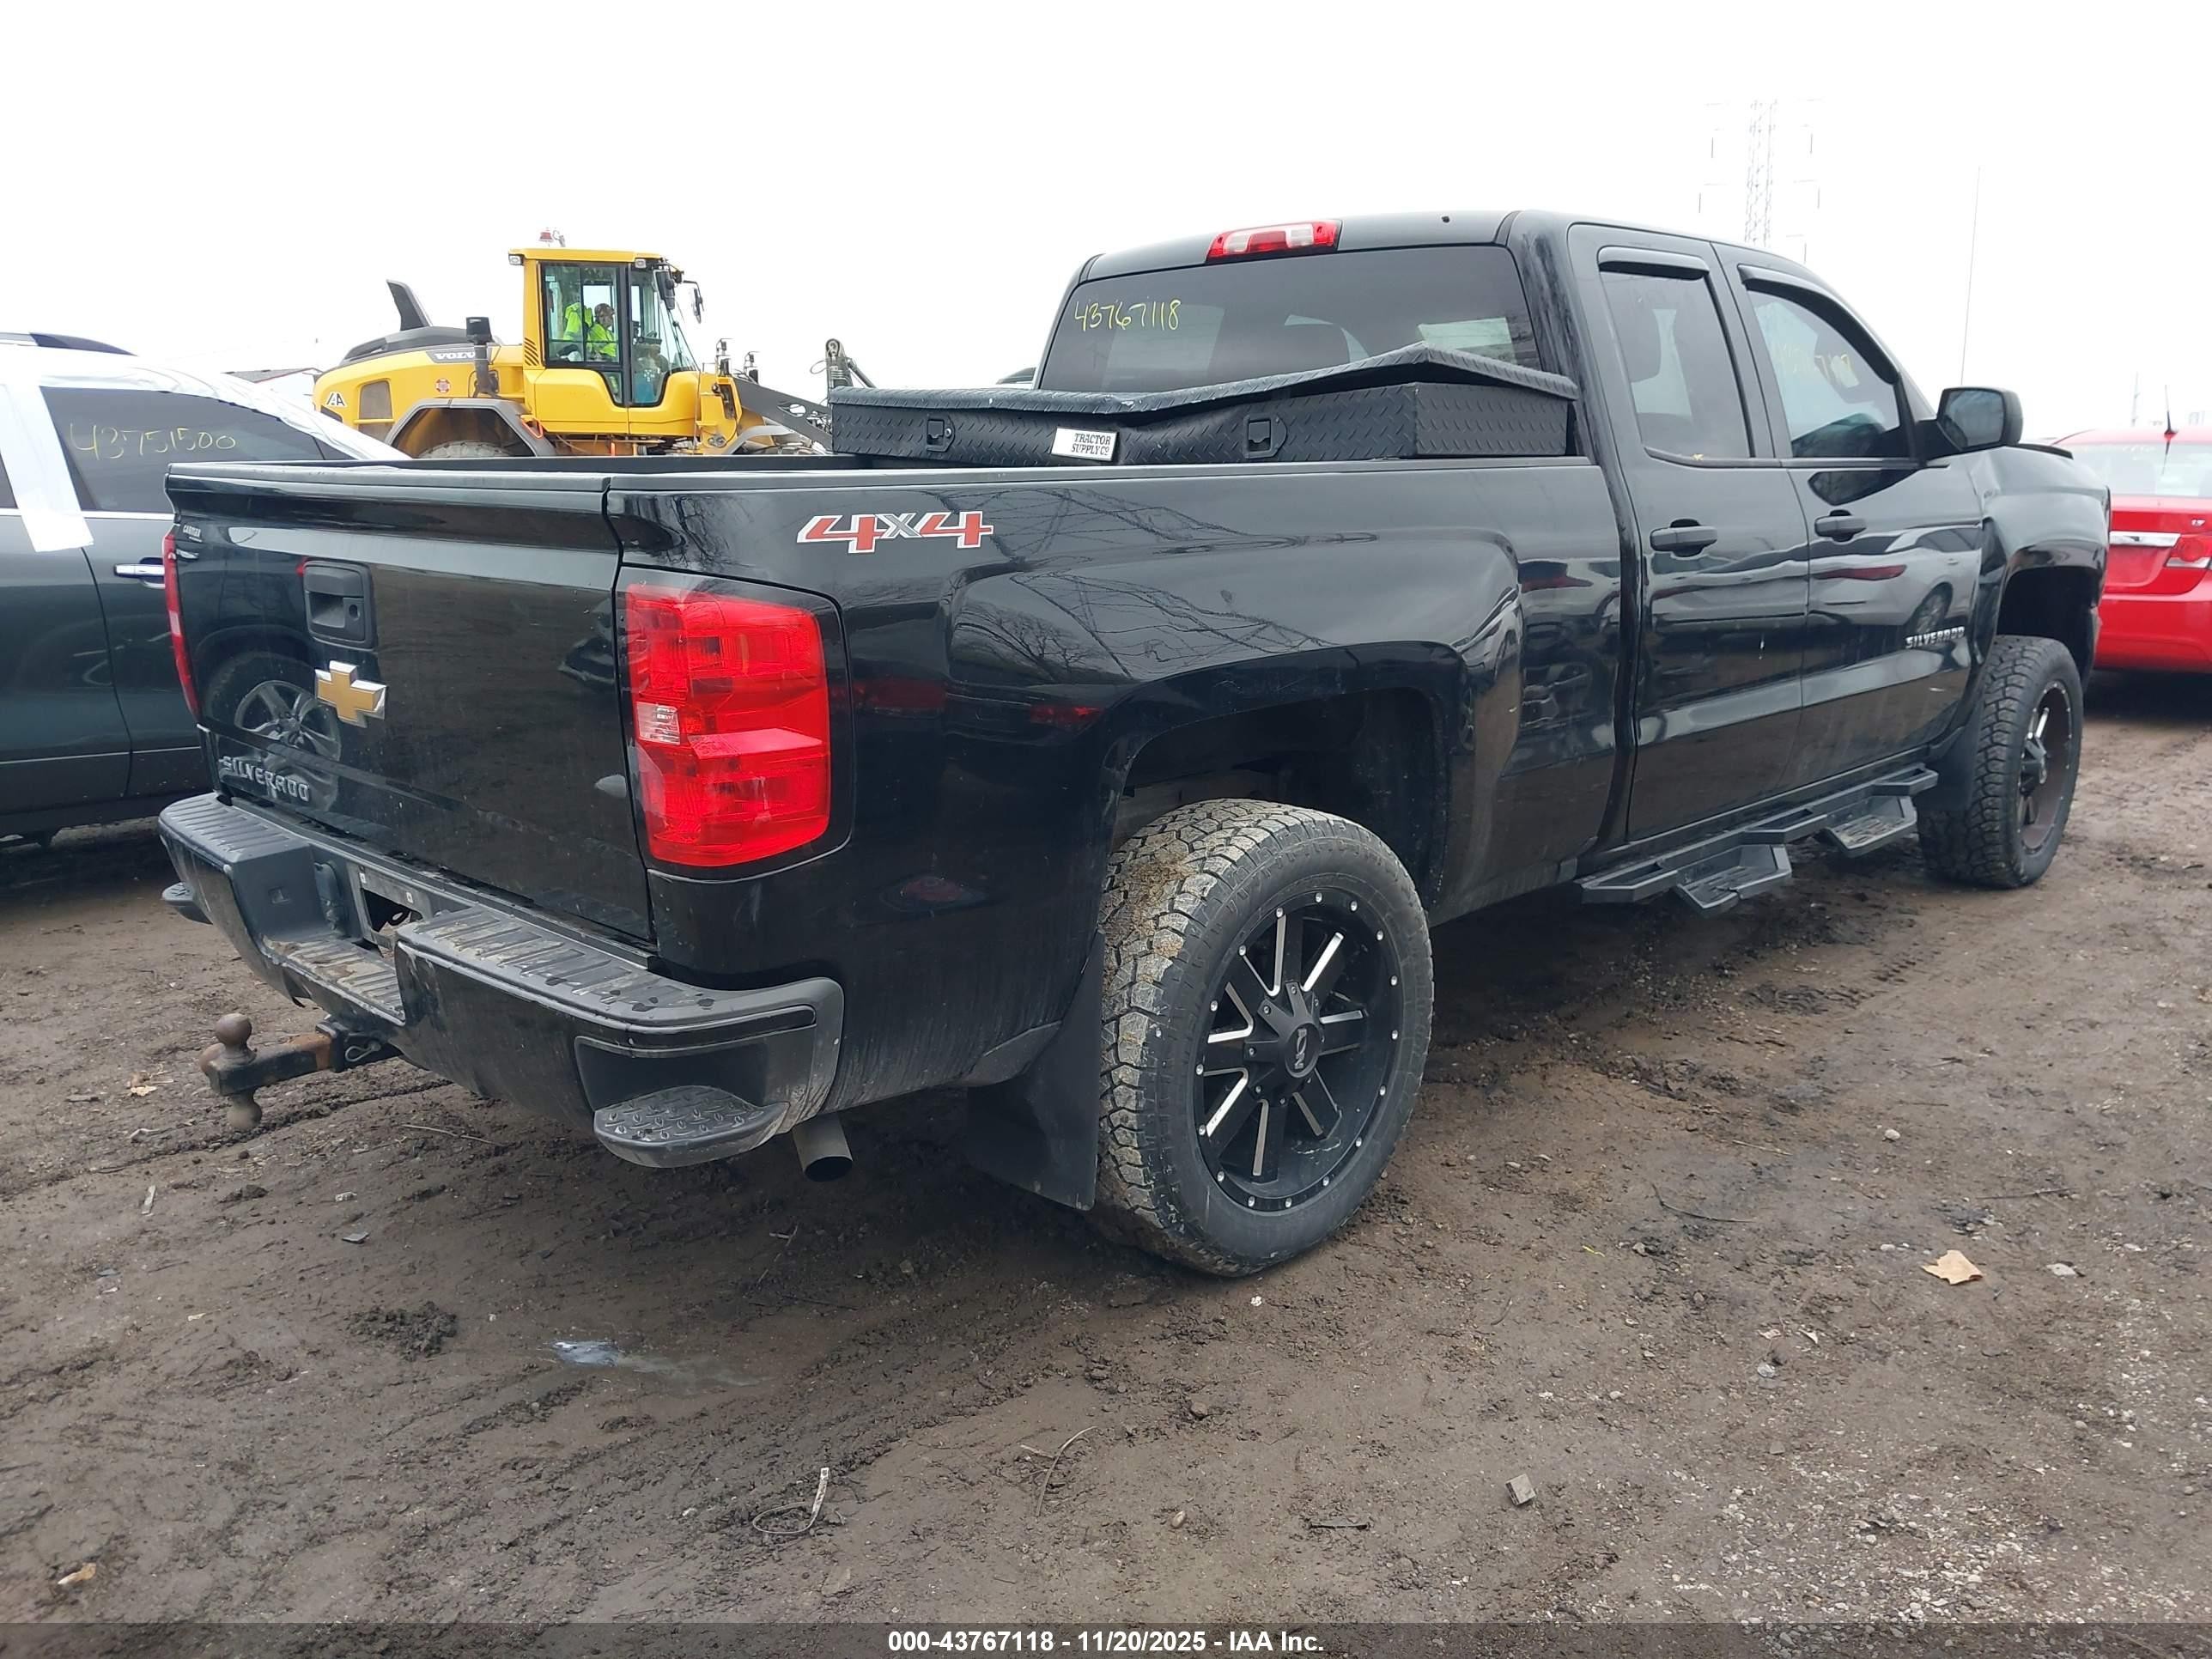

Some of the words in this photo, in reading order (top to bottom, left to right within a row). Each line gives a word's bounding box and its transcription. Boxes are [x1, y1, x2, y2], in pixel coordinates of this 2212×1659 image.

[1074, 300, 1181, 331] 43767118
[1074, 433, 1111, 446] TRACTOR
[1905, 626, 1966, 648] SILVERADO
[218, 756, 310, 802] SILVERADO
